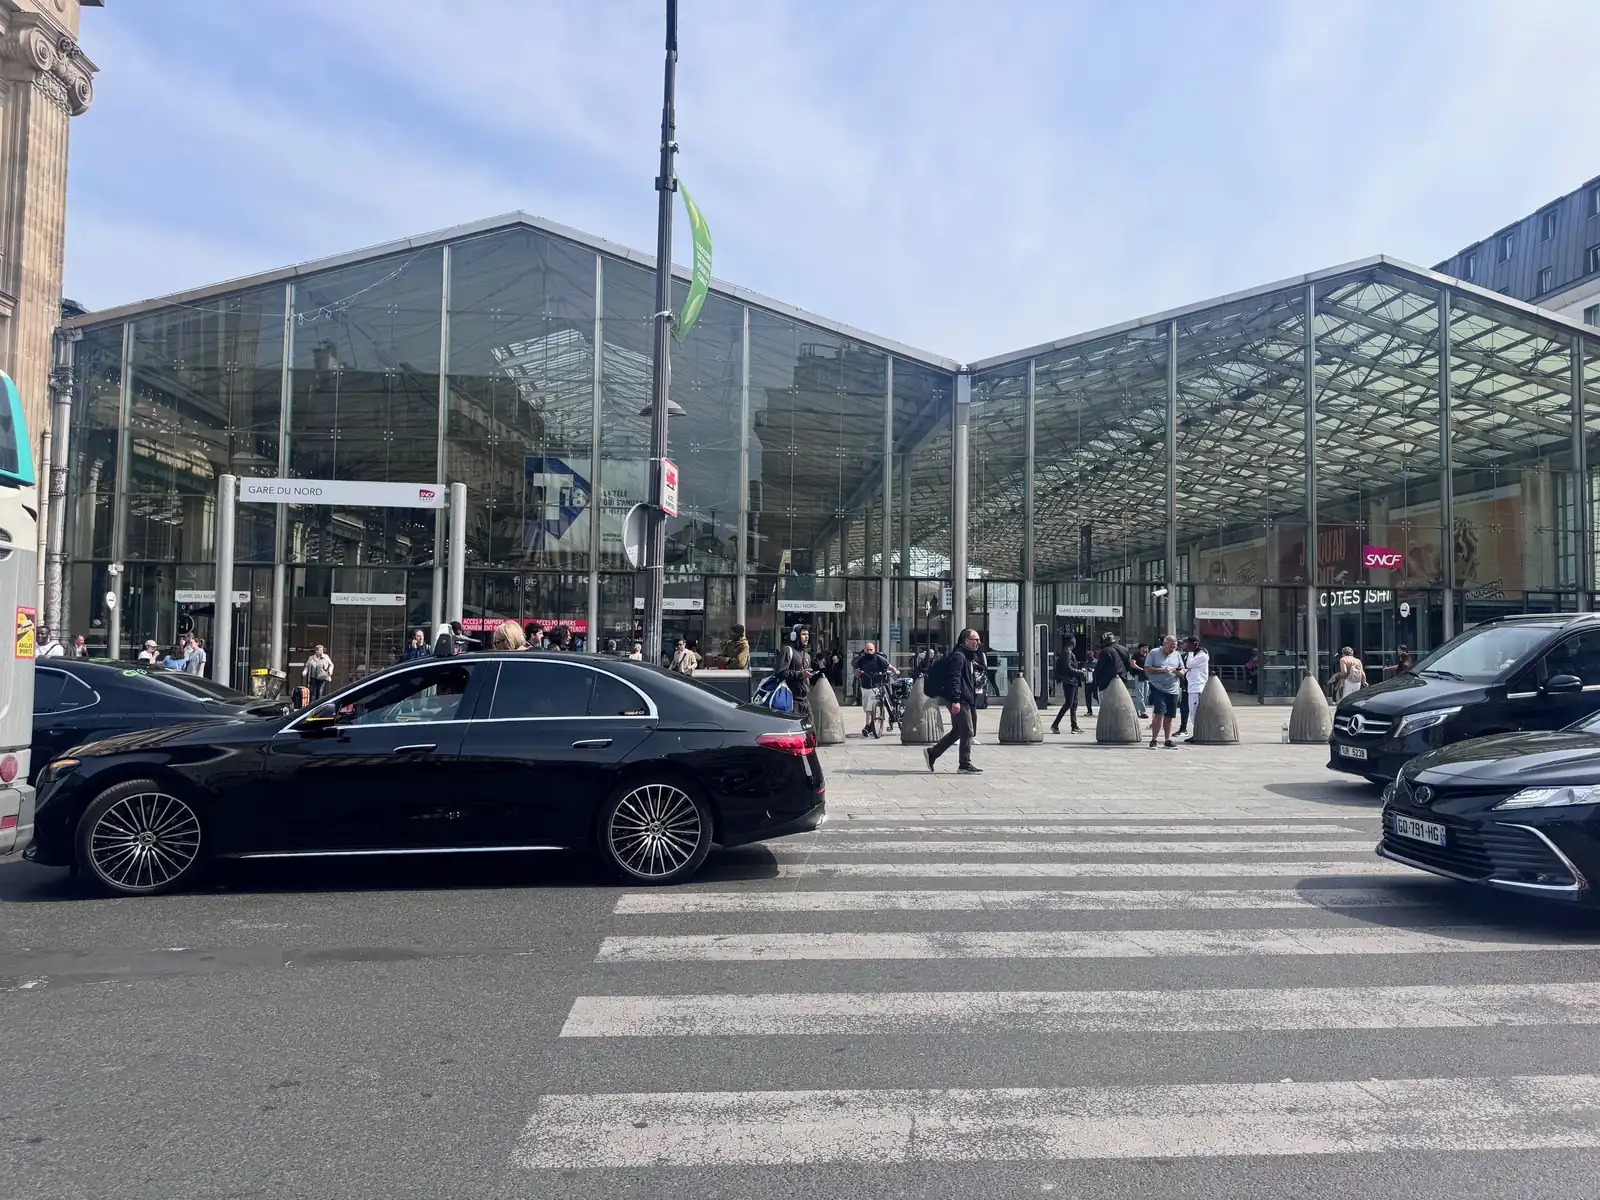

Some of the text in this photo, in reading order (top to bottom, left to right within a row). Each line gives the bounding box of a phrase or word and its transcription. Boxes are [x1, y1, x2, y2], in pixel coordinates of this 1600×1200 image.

[248, 485, 323, 496] GARE DU NORD
[1365, 554, 1402, 566] SNCF
